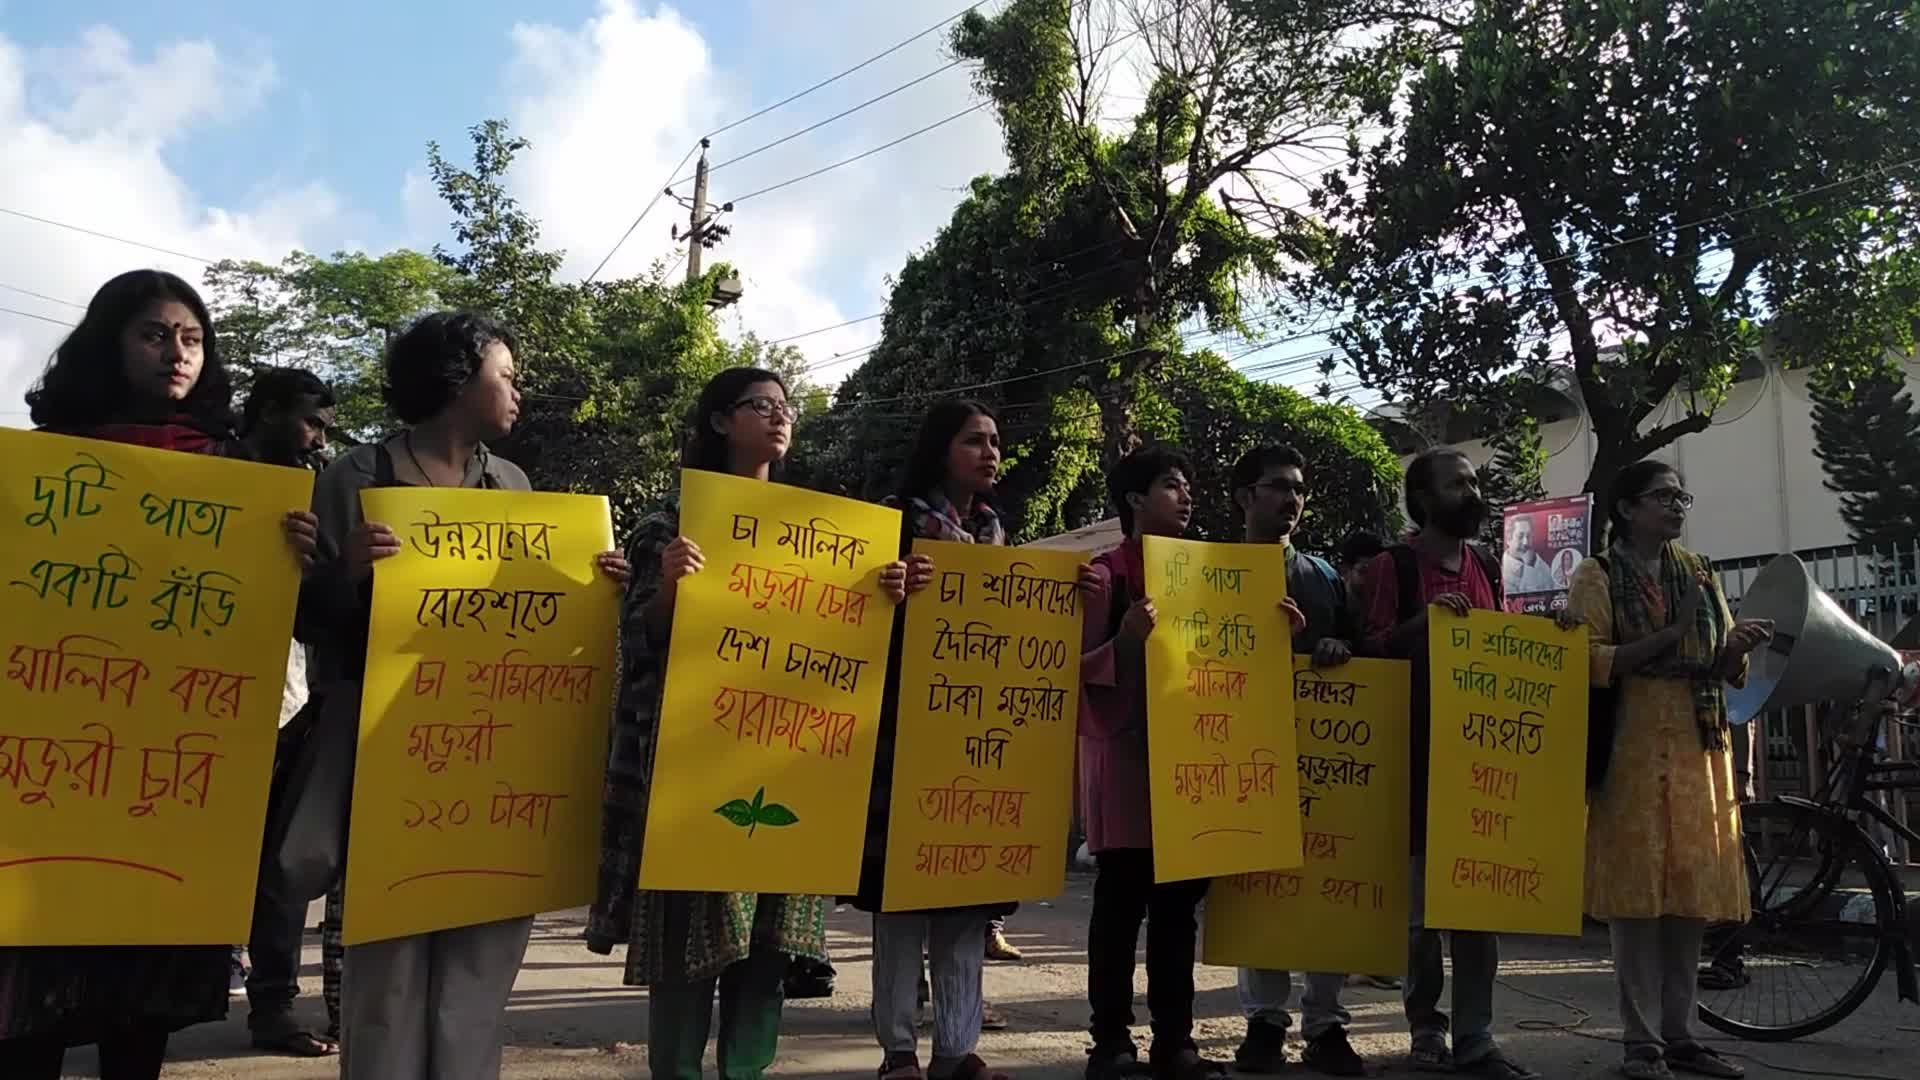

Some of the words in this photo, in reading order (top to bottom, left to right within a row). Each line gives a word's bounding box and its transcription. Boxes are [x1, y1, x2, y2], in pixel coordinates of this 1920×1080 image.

[26, 453, 124, 535] দুটি
[140, 493, 243, 547] পাতা
[410, 511, 557, 561] উন্নয়নের
[731, 513, 760, 549] চা
[777, 518, 870, 569] মালিক
[10, 545, 142, 610] একটি
[151, 567, 242, 636] কুঁড়ি
[729, 563, 814, 615] মজুরী
[816, 582, 872, 627] চোর
[940, 571, 965, 606] চা
[983, 561, 1081, 616] শ্রমিকদের
[1164, 553, 1192, 597] দুটি
[1201, 566, 1251, 595] পাতা
[717, 626, 769, 670] দেশ
[784, 642, 868, 694] চালায়
[932, 618, 1011, 669] দৈনিক
[1018, 635, 1066, 671] ৩০০
[1216, 614, 1256, 658] কুঁড়ি
[1451, 627, 1471, 650] চা
[1483, 625, 1568, 672] শ্রমিকদের
[8, 635, 150, 708] মালিক
[170, 665, 256, 720] করে
[416, 660, 448, 701] চা
[465, 649, 599, 705] শ্রমিকদের
[928, 673, 985, 720] টাকা
[999, 677, 1069, 727] মজুরীর
[1186, 658, 1248, 700] মালিক
[1452, 662, 1497, 701] দাবির
[1504, 675, 1557, 708] সাথে
[407, 710, 512, 772] মজুরী
[712, 686, 857, 758] হারামখোর
[1192, 712, 1232, 744] করে
[1310, 718, 1371, 747] ৩০০
[1463, 711, 1545, 755] সংহতি
[965, 728, 1013, 770] দাবি
[128, 733, 224, 817] চুরি
[1173, 753, 1230, 804] মজুরী
[1236, 748, 1280, 804] চুরি
[1471, 762, 1519, 801] প্রাণে
[404, 798, 471, 830] ১২০
[490, 782, 568, 841] টাকা
[1471, 807, 1513, 842] প্রাণ
[915, 842, 993, 877] মানতে
[995, 842, 1041, 877] হবে
[1452, 857, 1543, 902] মেলাবোই
[1320, 876, 1369, 907] হবে
